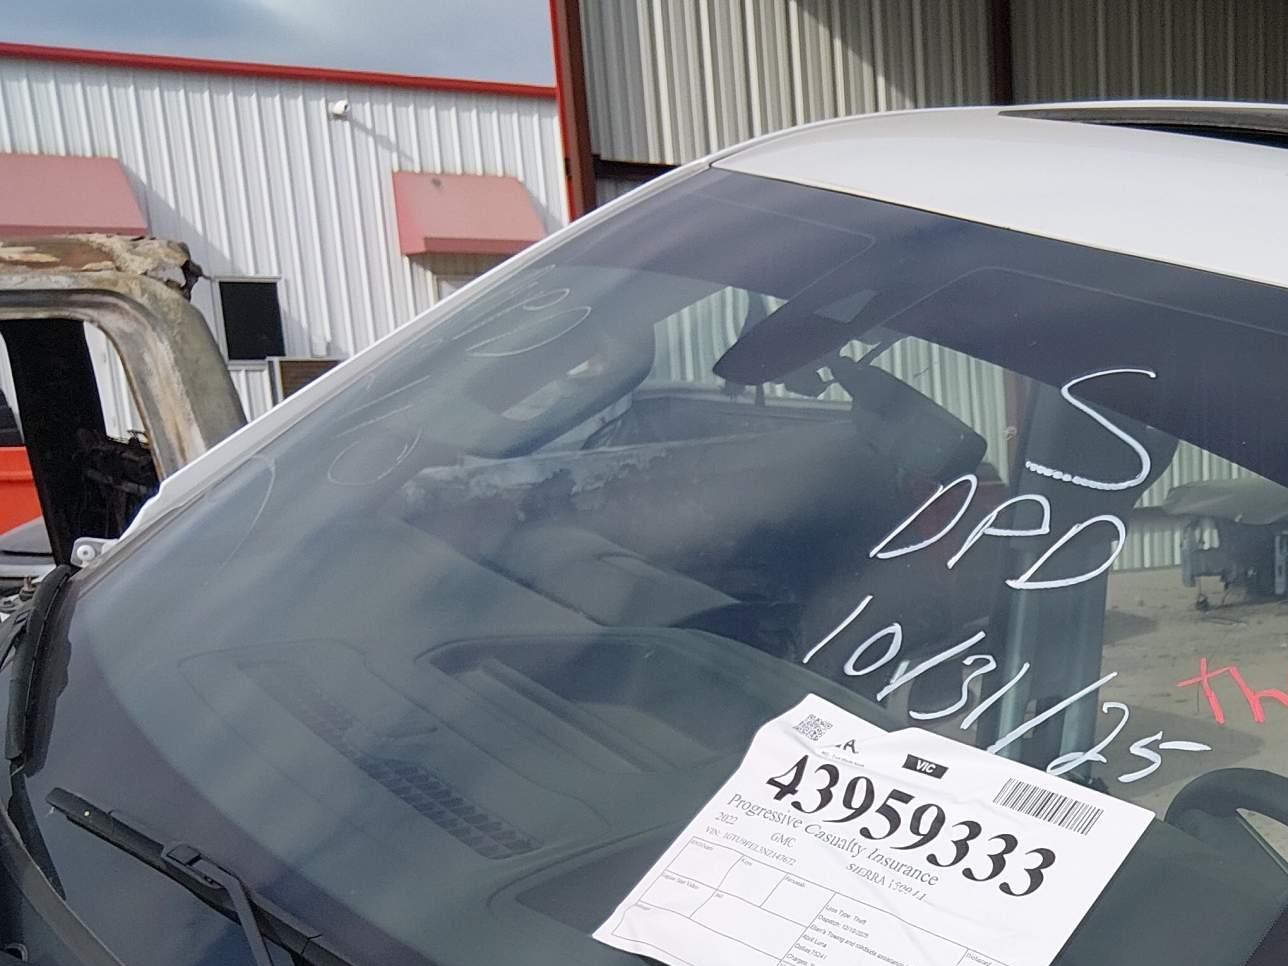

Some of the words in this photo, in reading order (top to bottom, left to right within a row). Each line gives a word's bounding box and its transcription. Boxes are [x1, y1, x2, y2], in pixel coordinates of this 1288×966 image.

[1025, 367, 1158, 491] S
[869, 473, 1128, 590] DPD
[802, 595, 1212, 784] 10/31/25
[914, 760, 937, 774] VIC
[715, 811, 738, 826] 2022
[770, 833, 797, 848] GMC
[846, 862, 886, 887] SIERRA
[727, 793, 803, 829] Progressive
[804, 823, 867, 858] Casualty
[866, 847, 940, 887] Insurance
[766, 754, 1057, 898] 43959333
